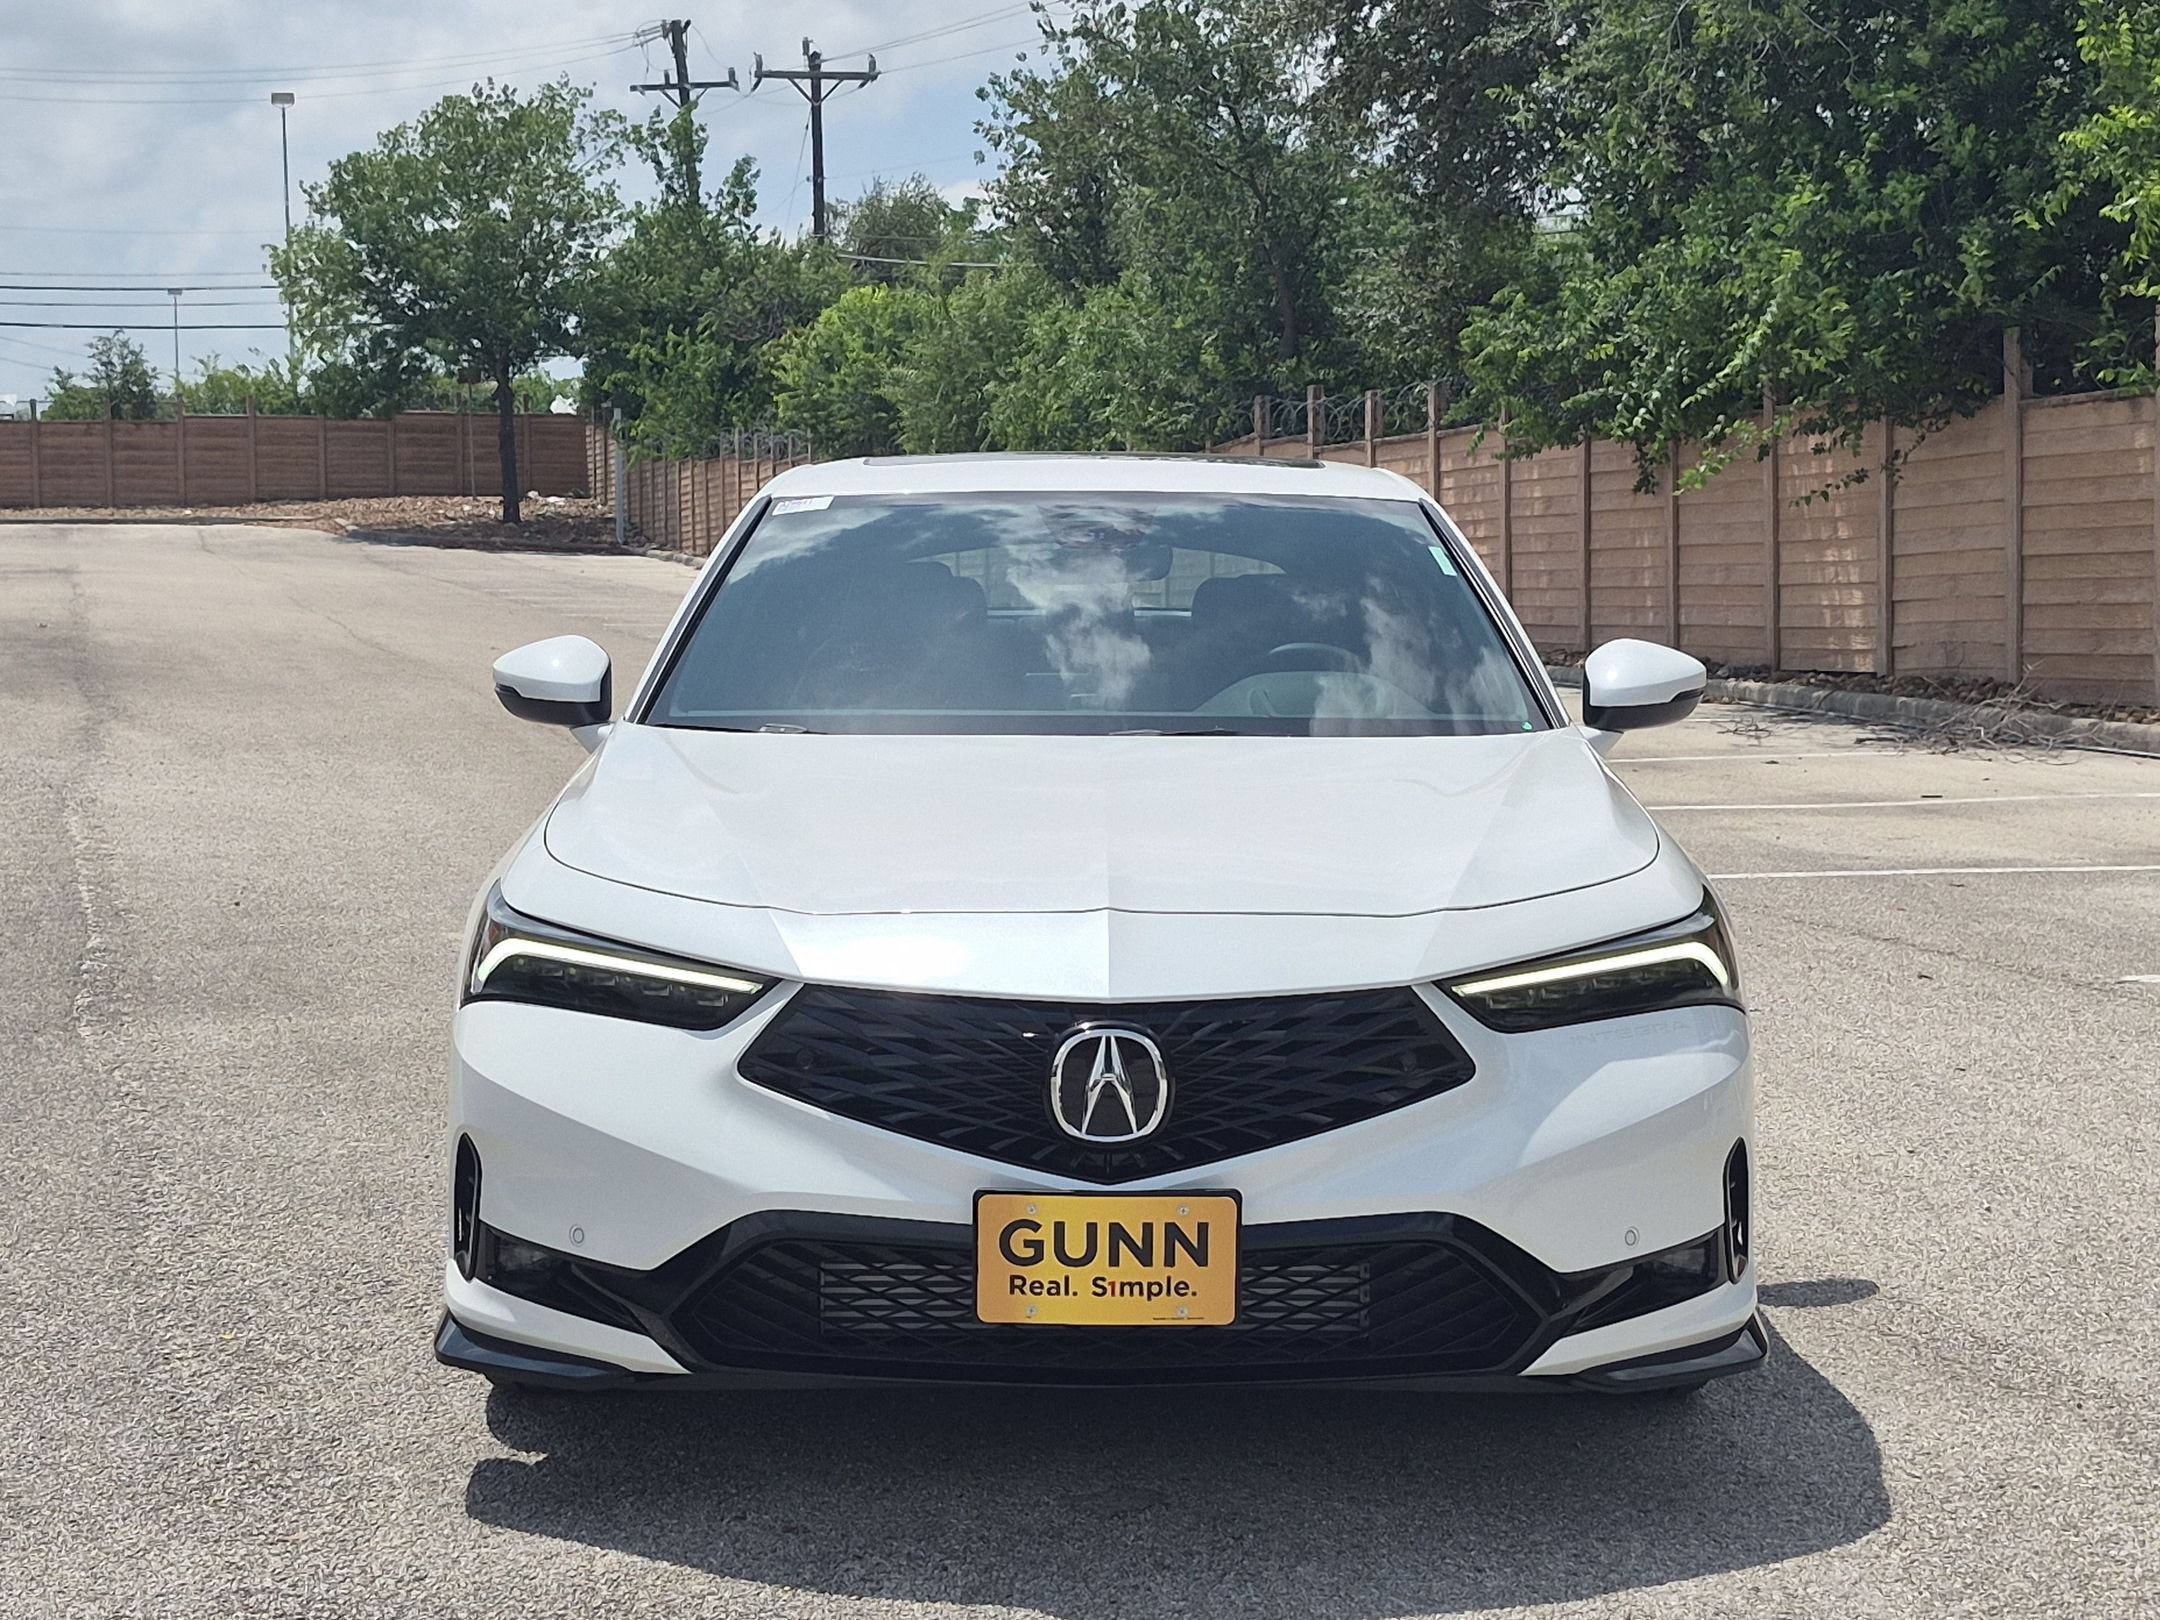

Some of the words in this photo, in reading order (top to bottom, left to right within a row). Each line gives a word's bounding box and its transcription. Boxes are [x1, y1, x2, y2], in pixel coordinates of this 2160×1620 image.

[999, 1219, 1209, 1268] GUNN
[1009, 1275, 1078, 1296] Real.
[1091, 1275, 1198, 1301] S1mple.
